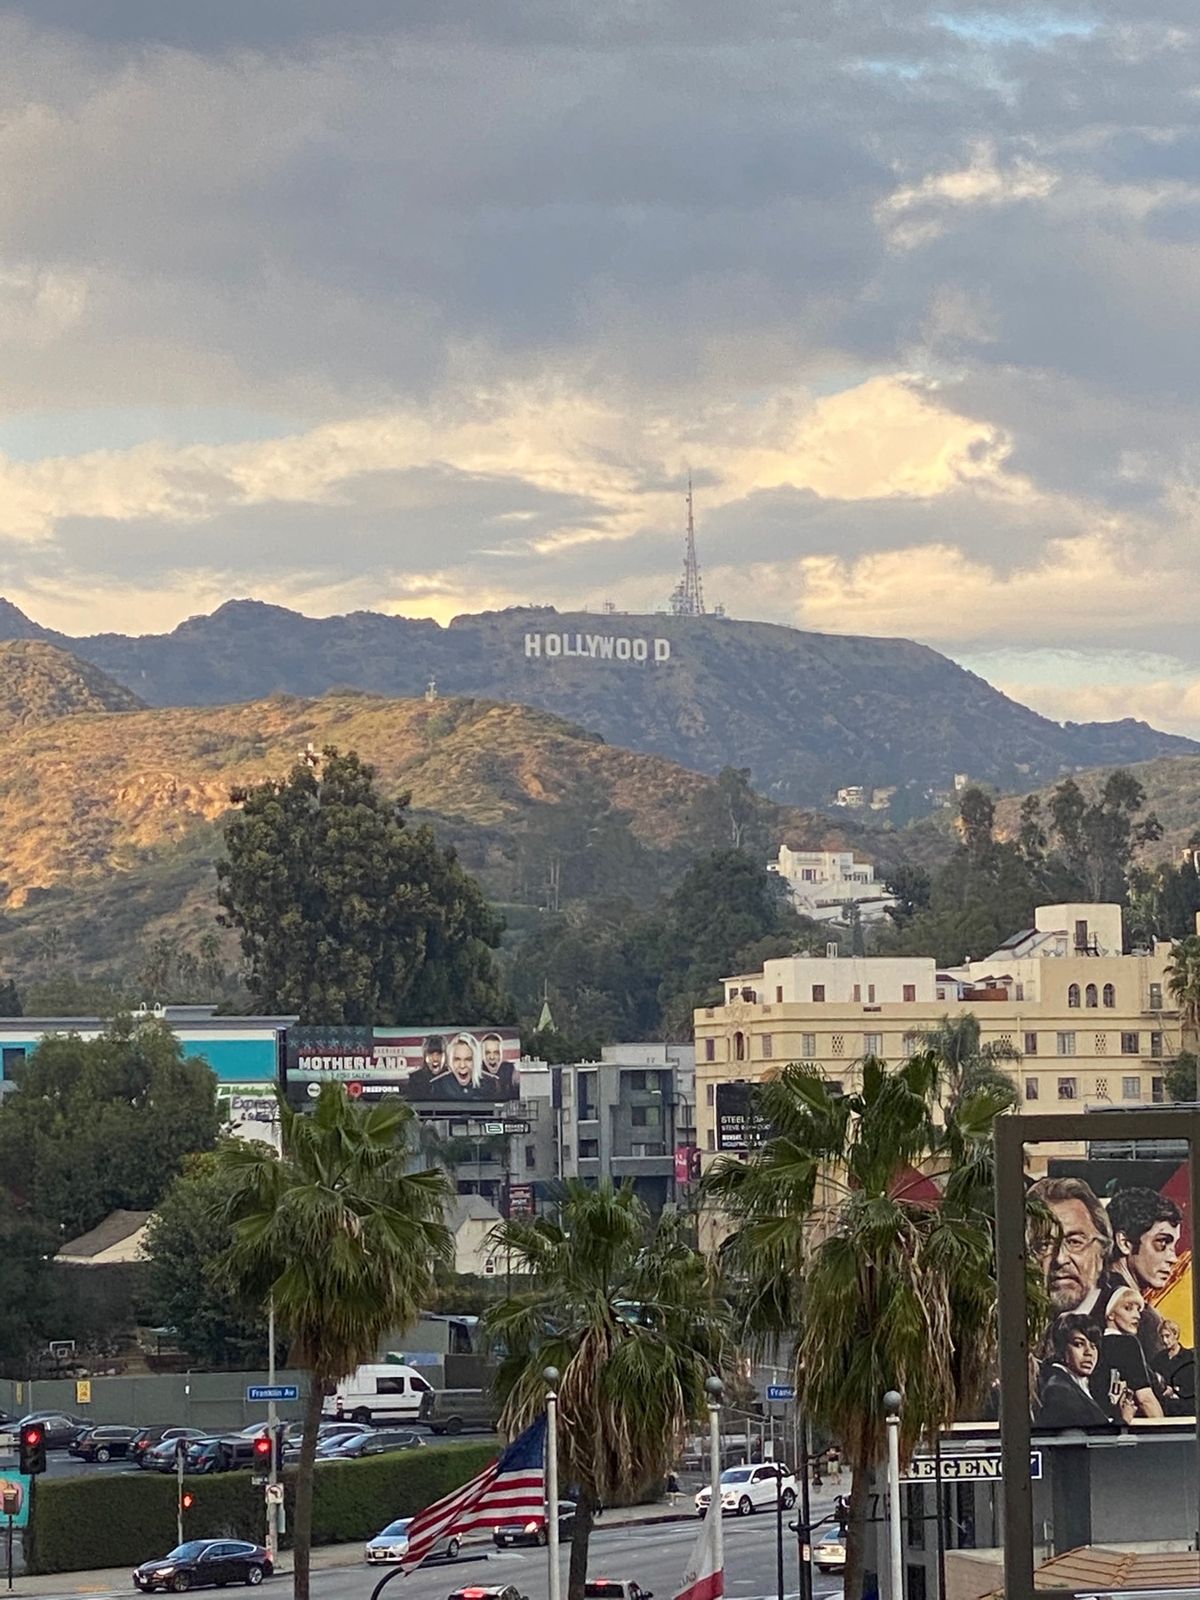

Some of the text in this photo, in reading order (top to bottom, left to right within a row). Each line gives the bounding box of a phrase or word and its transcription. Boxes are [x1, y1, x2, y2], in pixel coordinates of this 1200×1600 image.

[524, 633, 671, 661] HOLLYWOOD
[298, 1056, 408, 1071] MOTHERLAND
[362, 1085, 399, 1093] FREEFORM
[721, 1115, 744, 1124] STEEL
[252, 1389, 282, 1397] Franklin
